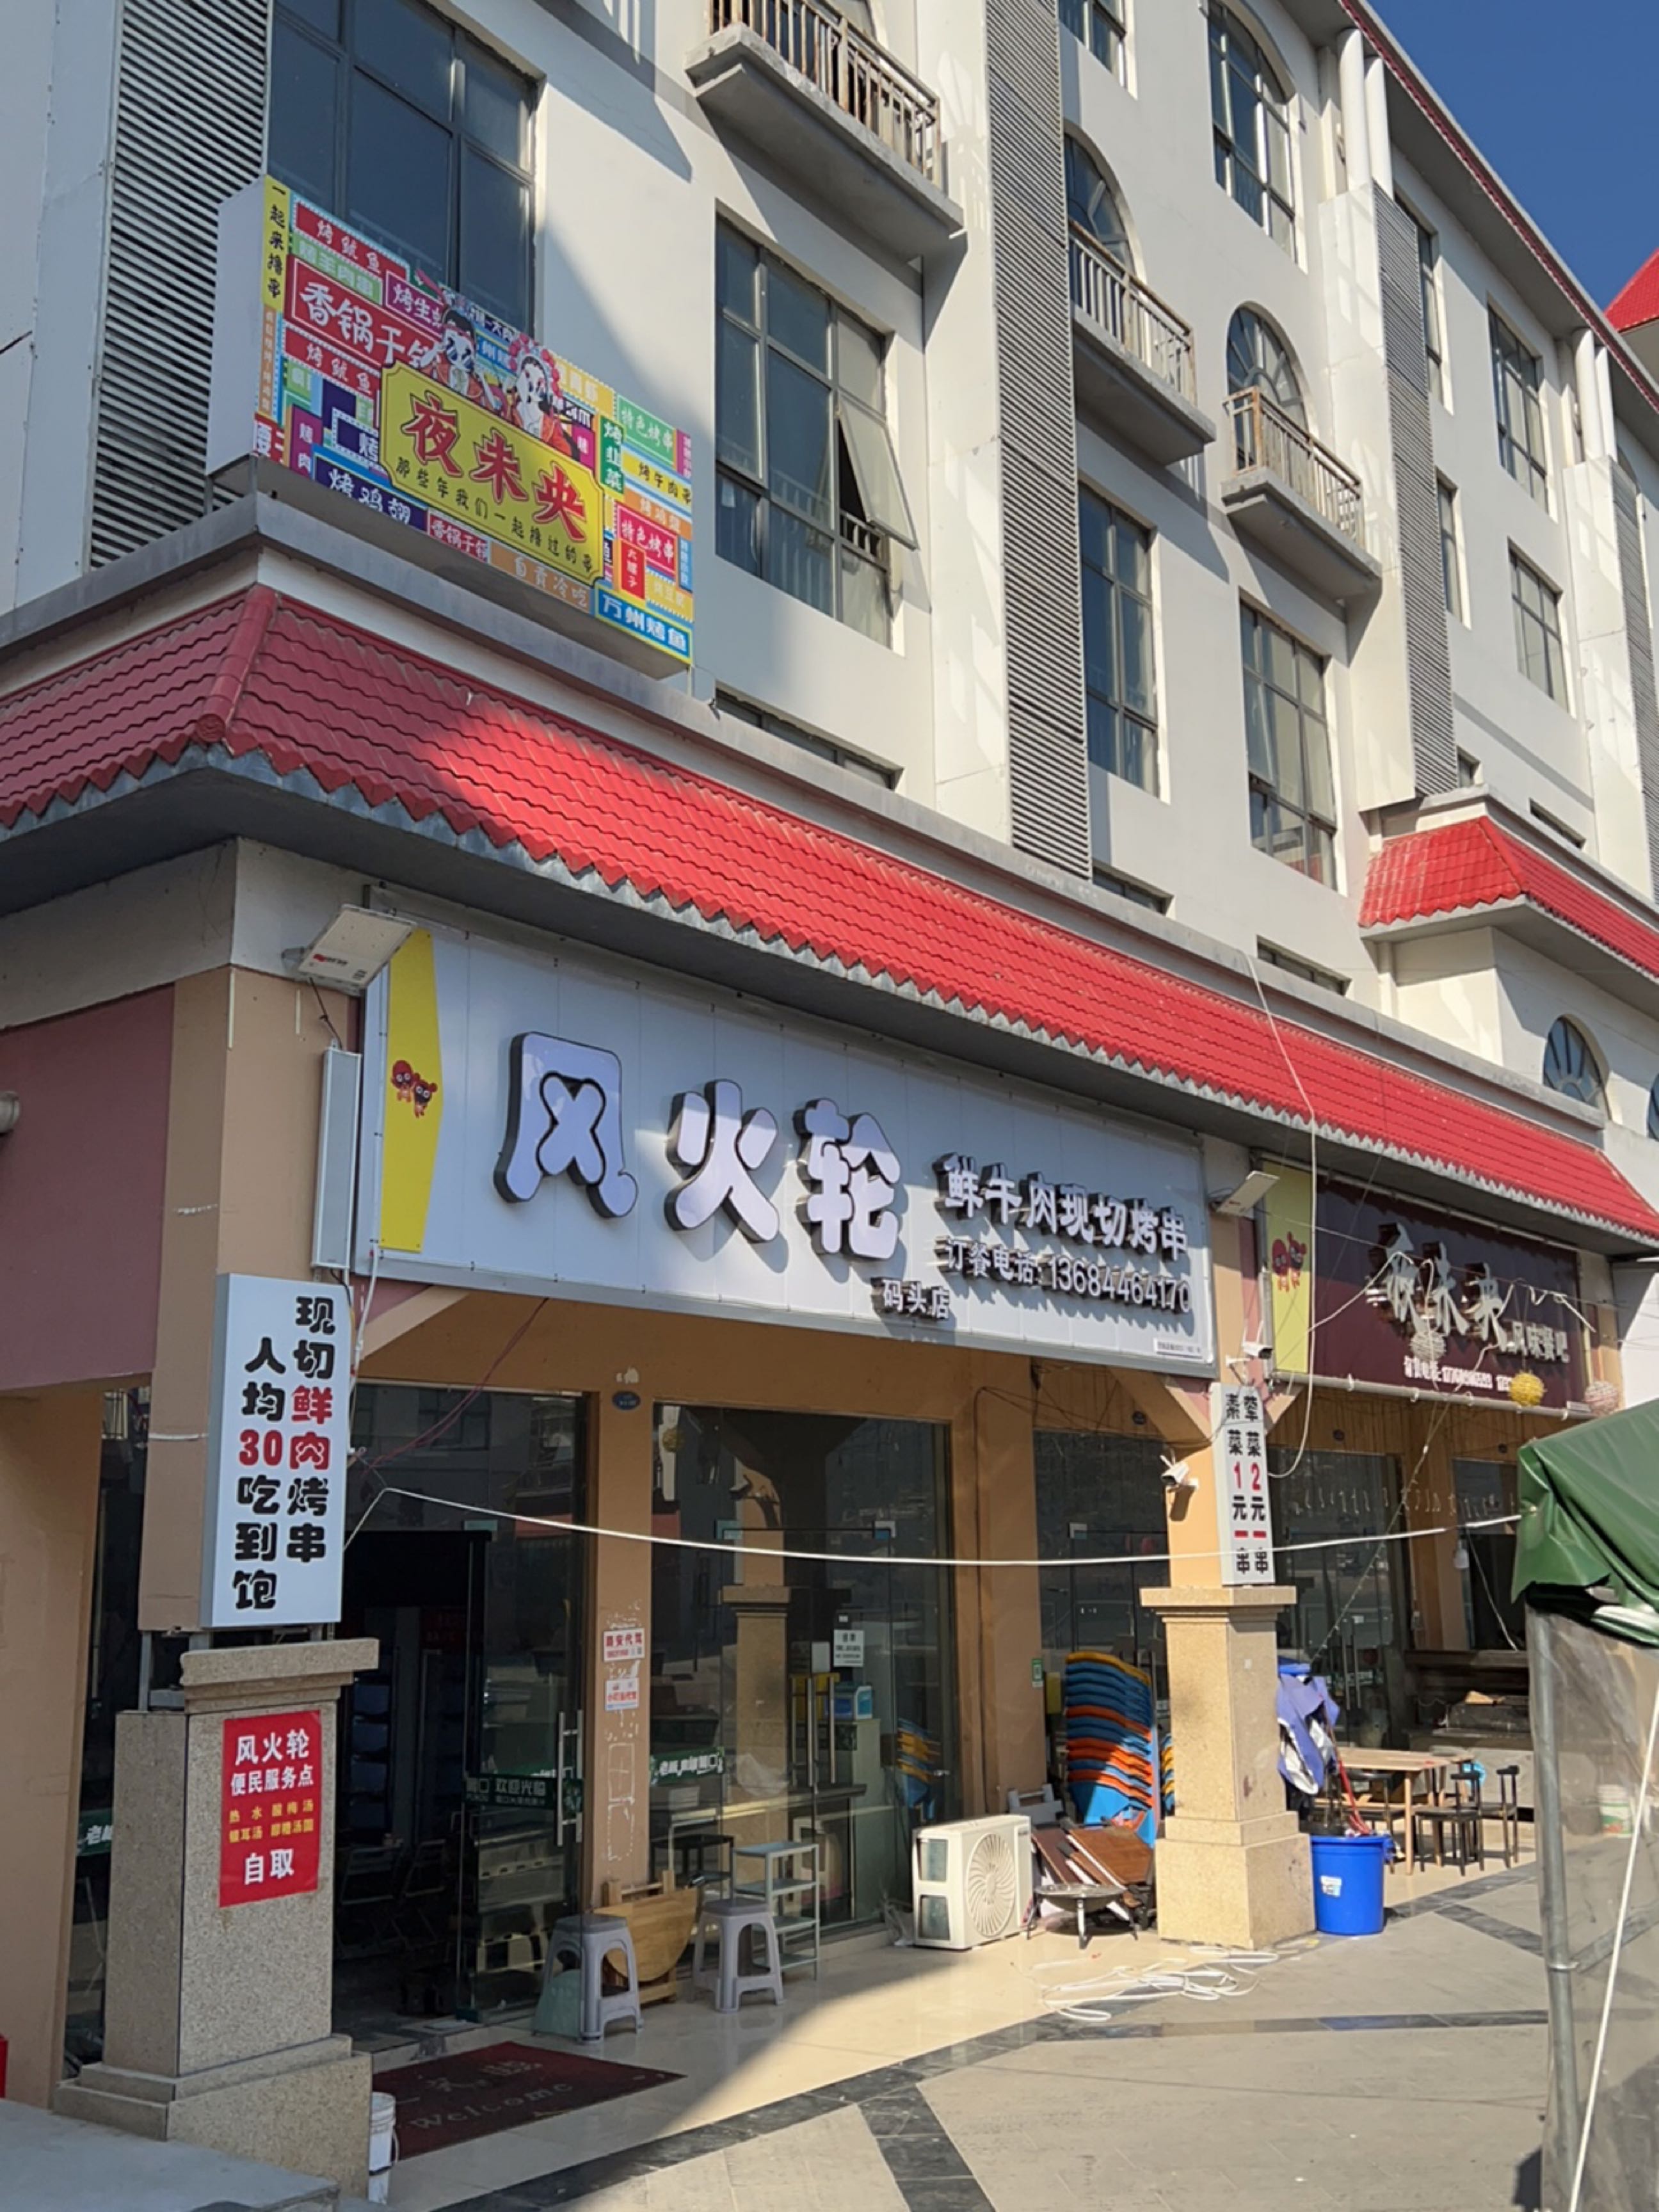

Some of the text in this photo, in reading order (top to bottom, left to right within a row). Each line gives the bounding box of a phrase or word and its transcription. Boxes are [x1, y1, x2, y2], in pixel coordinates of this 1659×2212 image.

[400, 390, 588, 542] 夜未央
[493, 1030, 901, 1260] 风火轮
[938, 1153, 1188, 1261] 鲜牛肉现切烤串
[878, 1278, 950, 1322] 码头店
[232, 1336, 287, 1611] 人均30吃到饱
[285, 1295, 336, 1564] 现切鲜肉烤串
[230, 1764, 314, 1797] 便民服务点
[235, 1727, 310, 1766] 风火轮
[243, 1848, 294, 1886] 自取
